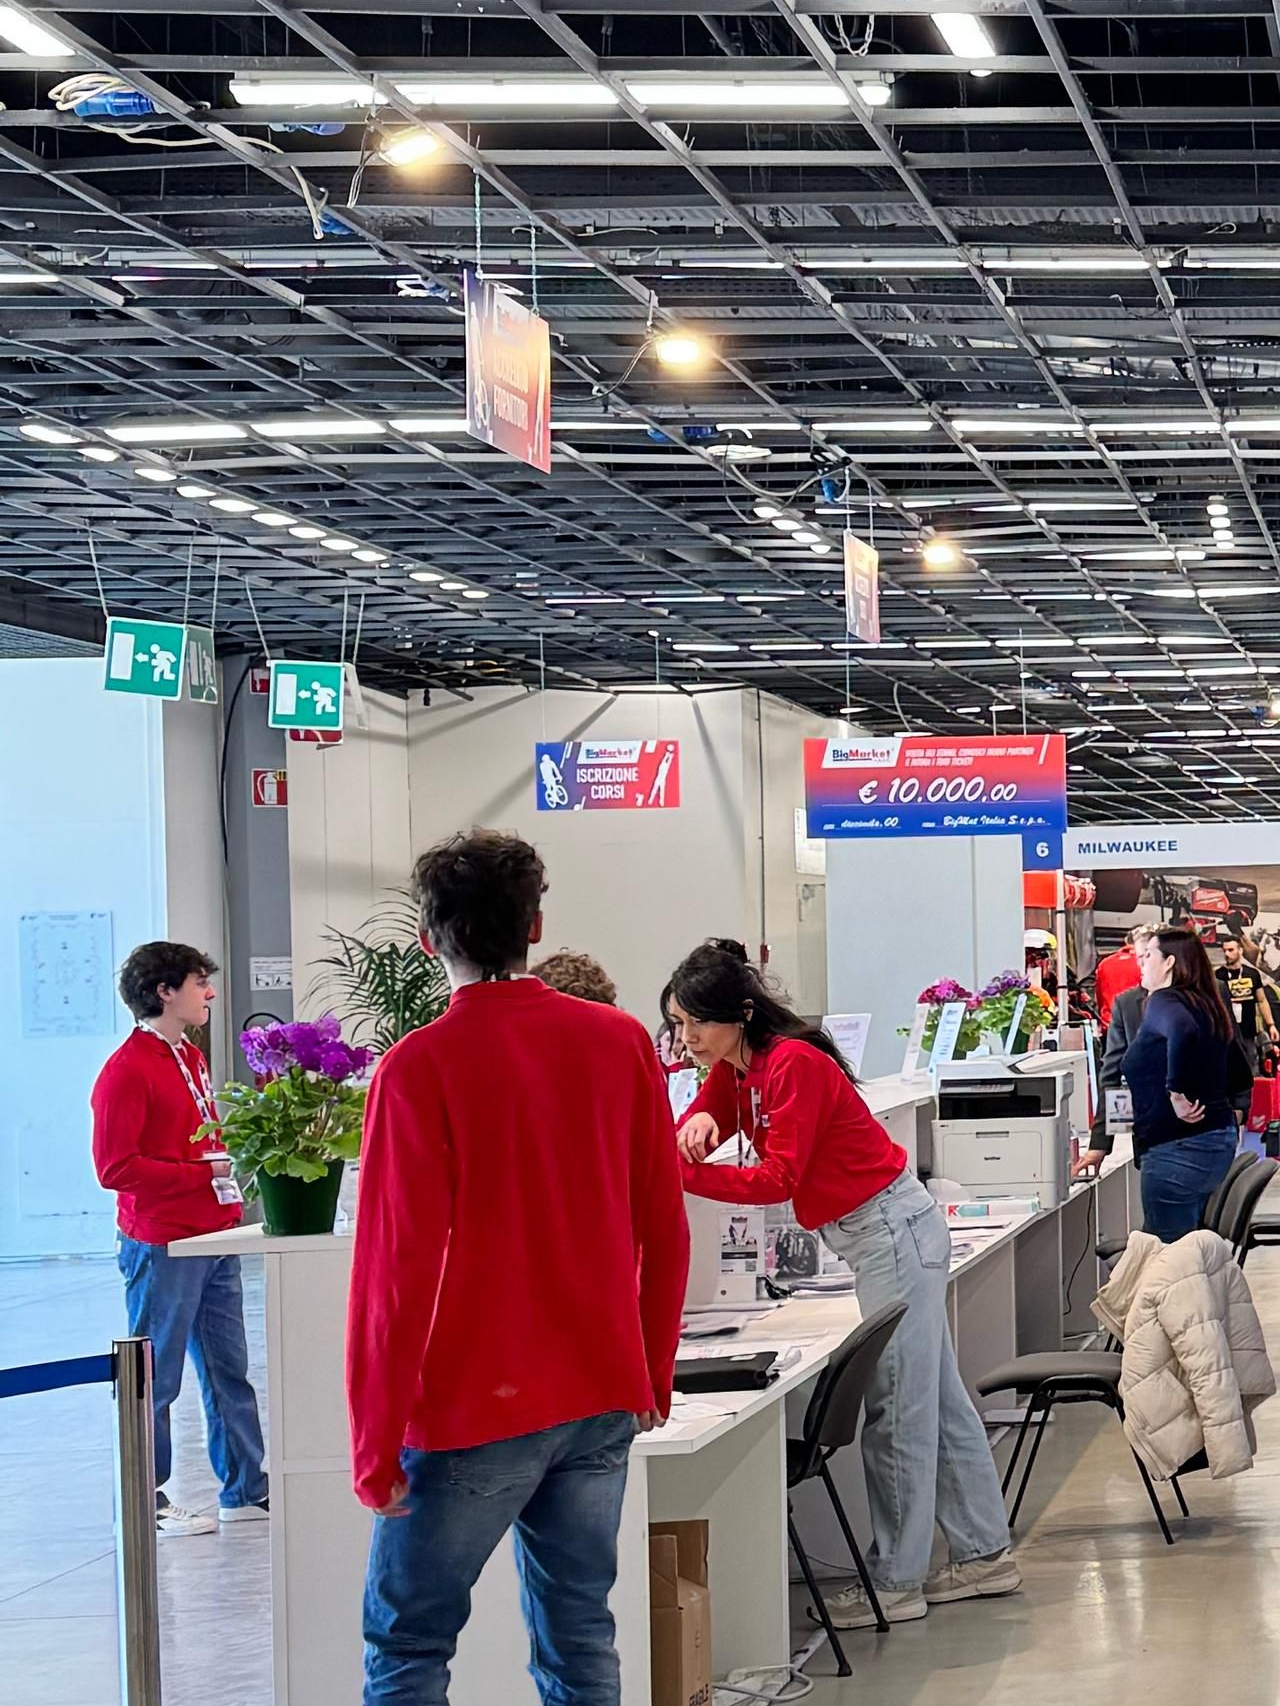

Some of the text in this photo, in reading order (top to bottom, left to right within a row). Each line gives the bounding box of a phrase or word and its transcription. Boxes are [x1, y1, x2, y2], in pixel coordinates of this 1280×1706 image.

[576, 767, 639, 783] ISCRIZIONE
[591, 784, 625, 799] CORSI
[859, 776, 1018, 804] € 10.000,00
[1036, 842, 1049, 857] 6
[1078, 840, 1178, 854] MILWAUKEE
